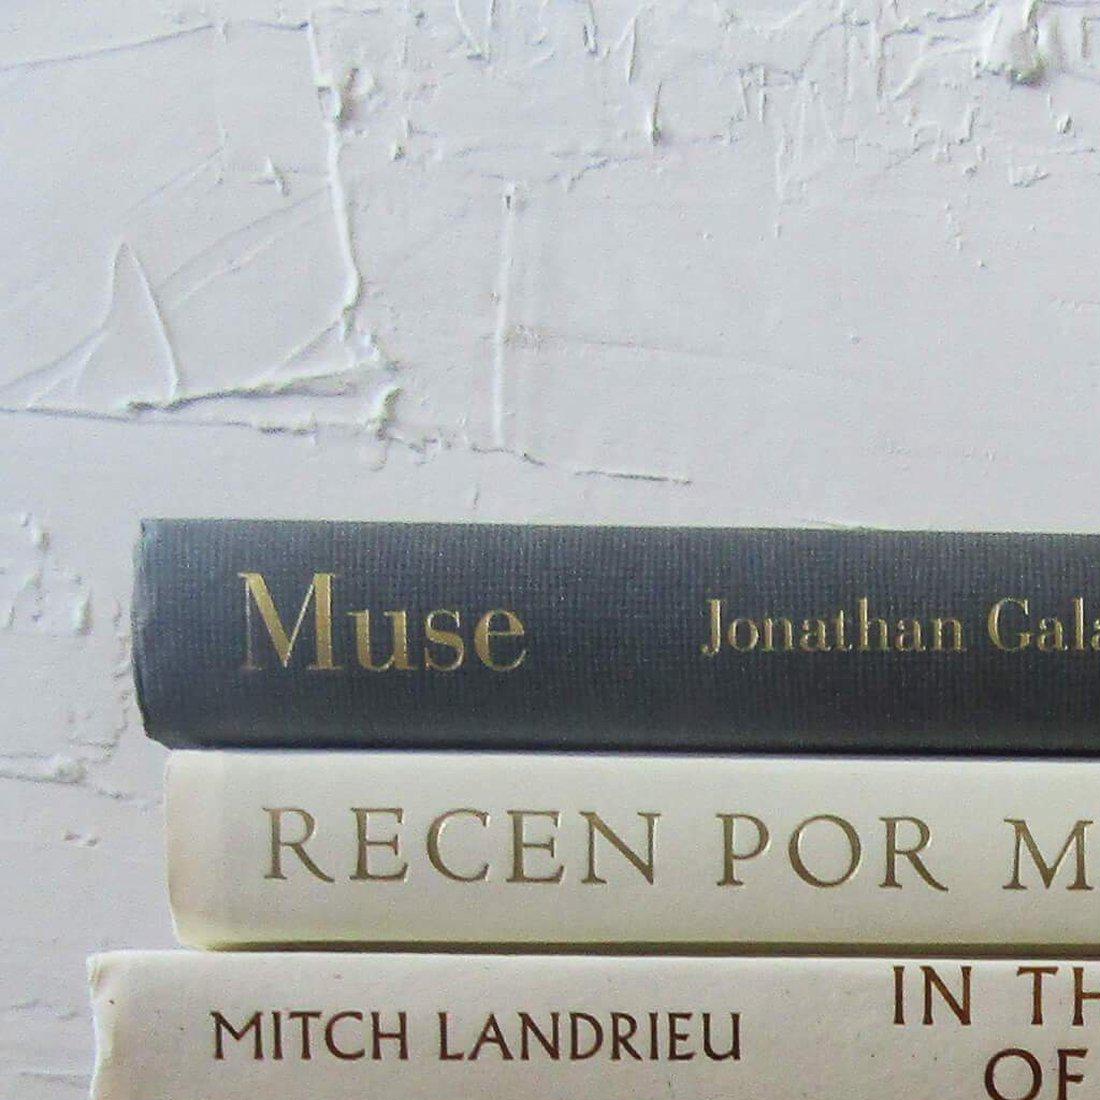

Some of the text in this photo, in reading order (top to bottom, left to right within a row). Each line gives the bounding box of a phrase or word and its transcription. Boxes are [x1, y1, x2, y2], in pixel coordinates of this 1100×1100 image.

[238, 571, 527, 675] Muse
[701, 597, 965, 656] Jonathan
[264, 807, 662, 887] RECEN
[716, 812, 948, 892] POR
[891, 966, 972, 1026] IN
[210, 1010, 742, 1062] MITCH LANDRIEU
